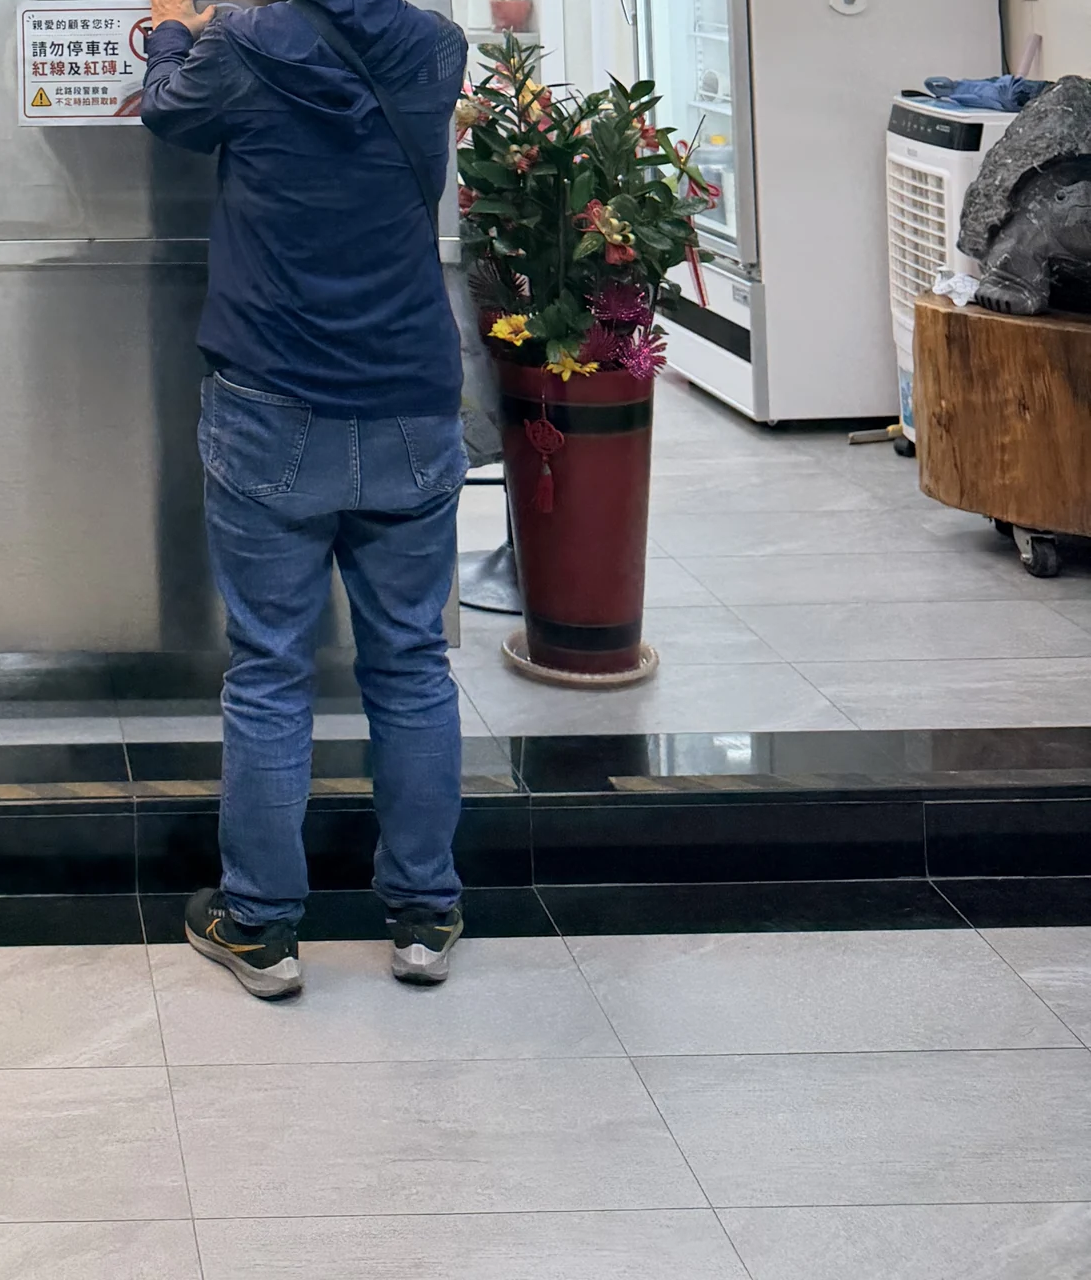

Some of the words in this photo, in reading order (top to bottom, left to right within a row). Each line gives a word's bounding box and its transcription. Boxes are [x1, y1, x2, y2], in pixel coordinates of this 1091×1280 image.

[32, 19, 121, 31] 親愛的顧客您好：
[31, 40, 119, 57] 請勿停車在
[31, 60, 133, 77] 紅線及紅磚上
[55, 86, 109, 96] 此路段警察會
